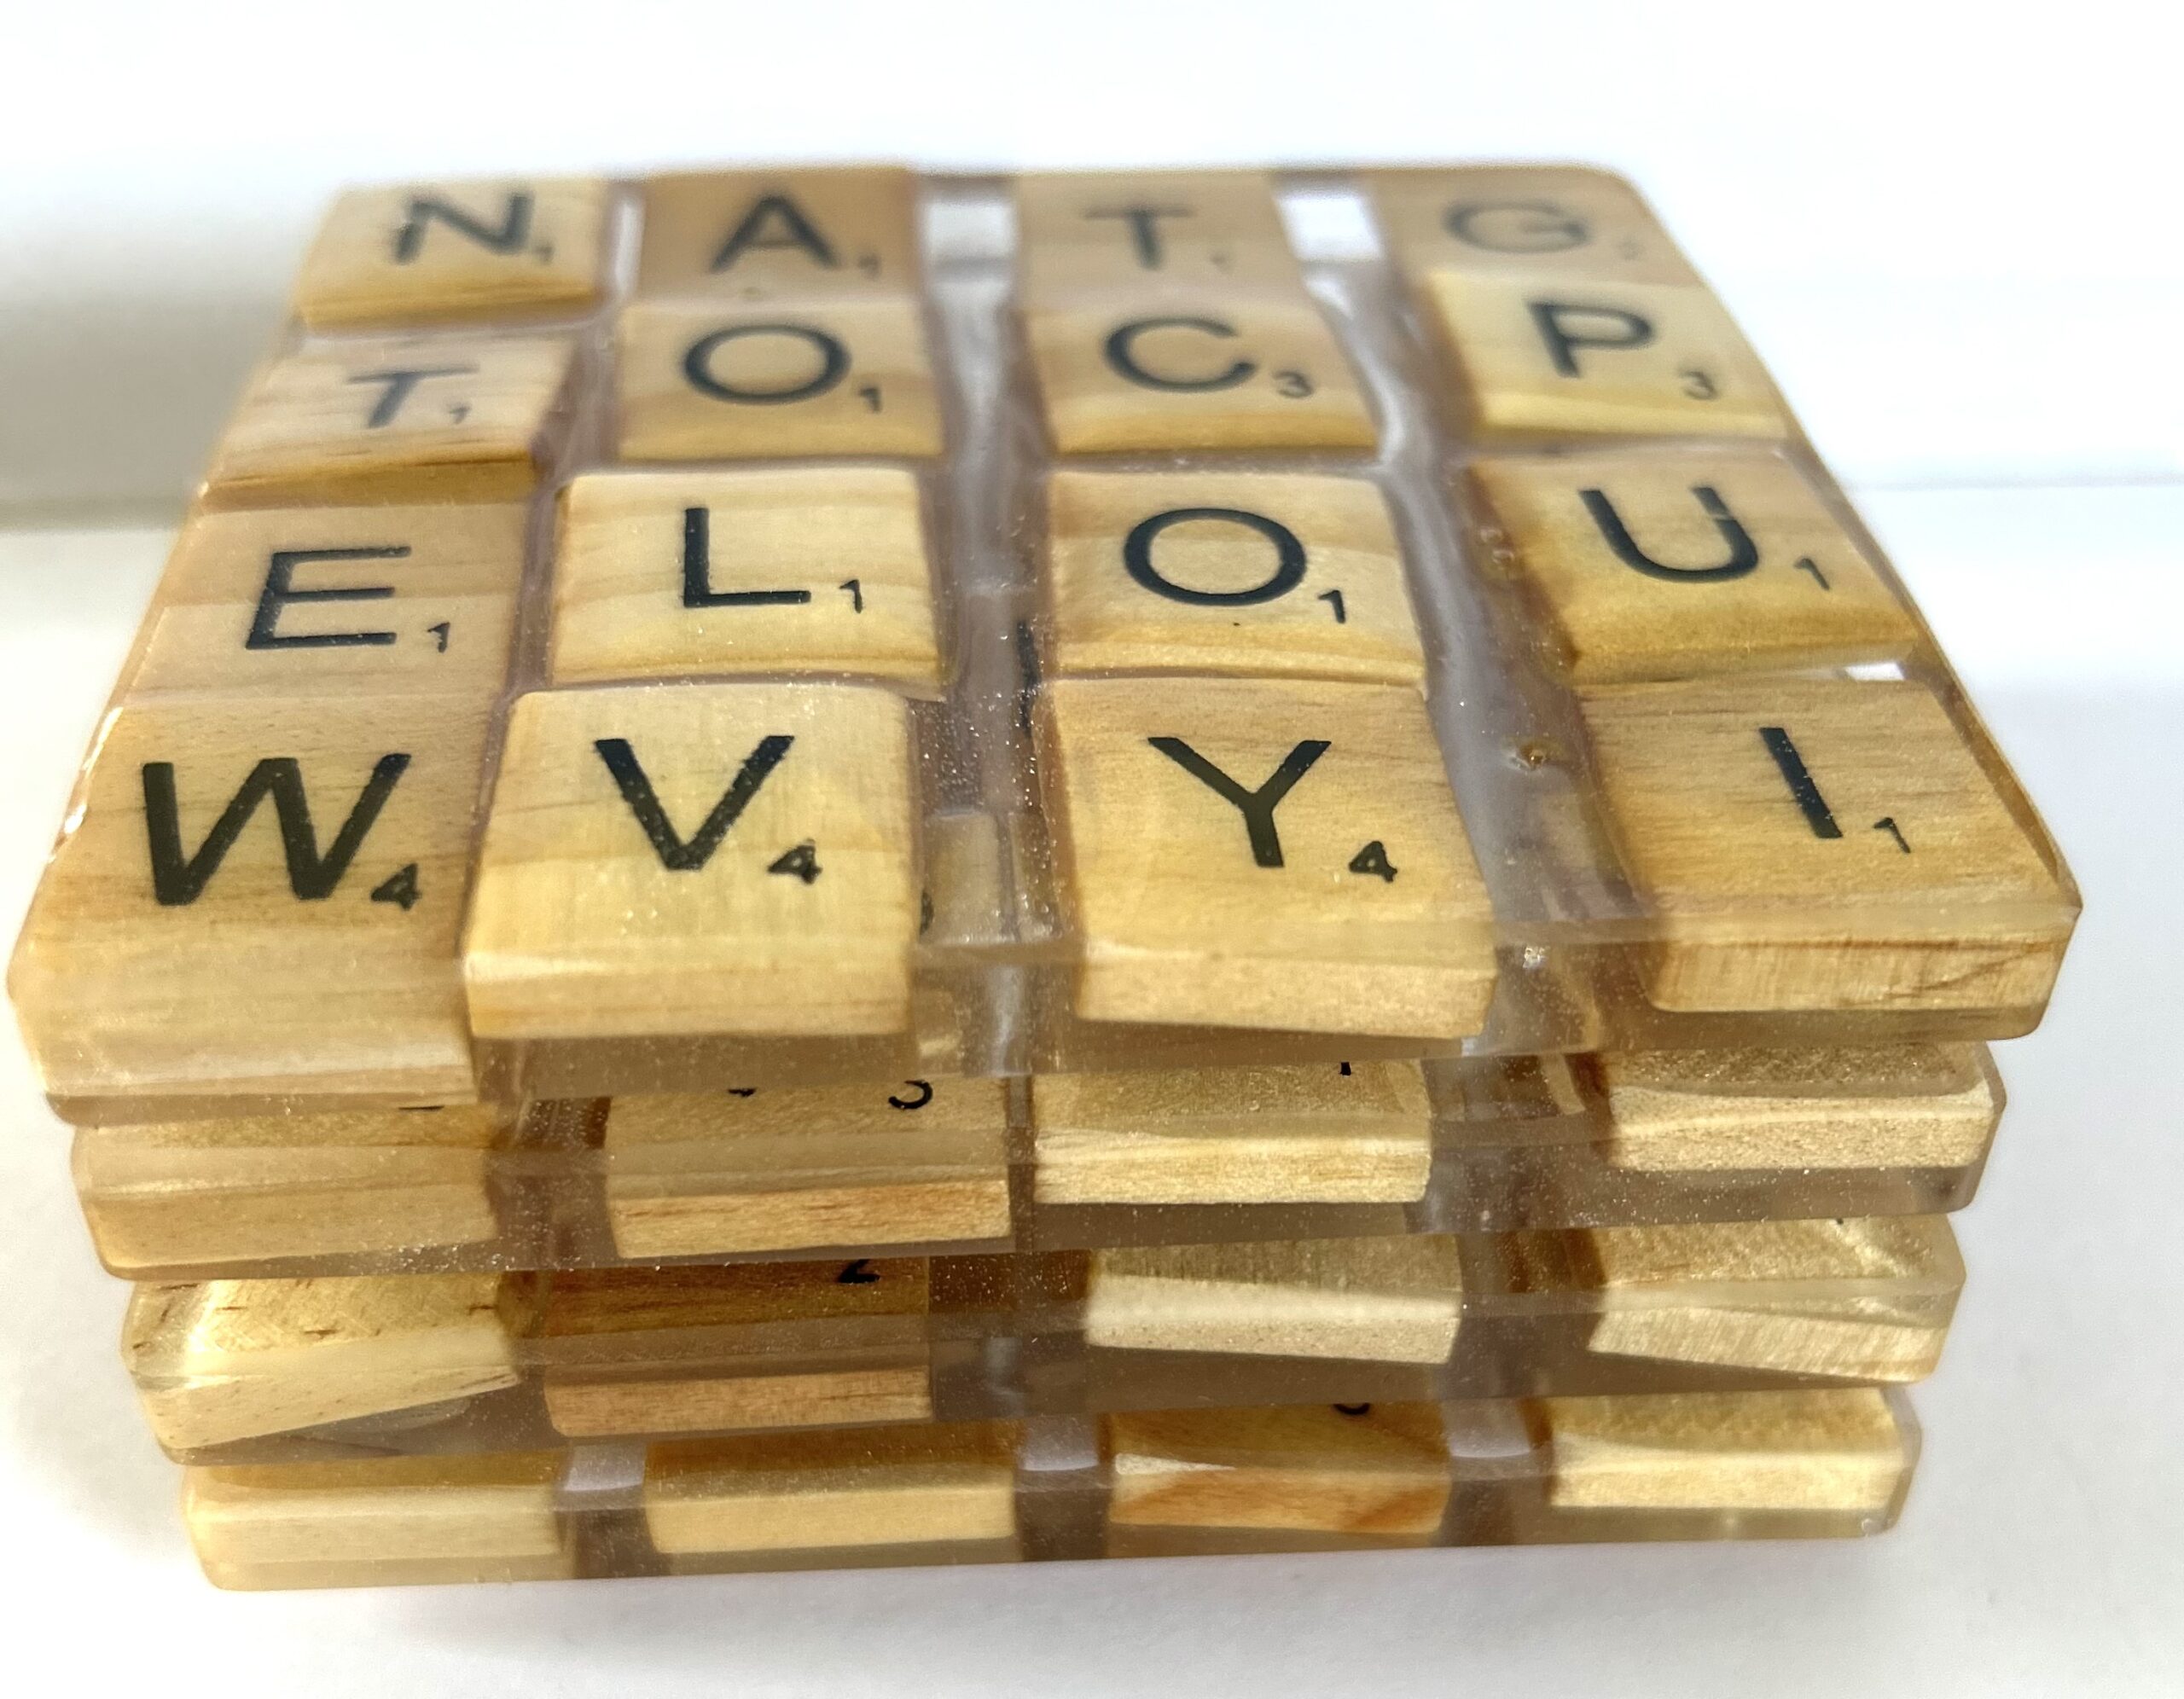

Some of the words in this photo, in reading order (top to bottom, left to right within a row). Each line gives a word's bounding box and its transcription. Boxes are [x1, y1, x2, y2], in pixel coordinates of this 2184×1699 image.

[393, 192, 533, 264] N
[711, 193, 840, 270] A
[1082, 204, 1197, 270] T
[1441, 198, 1592, 253] G
[347, 364, 479, 428] T
[682, 325, 849, 404] O
[1103, 316, 1258, 392] C
[1272, 371, 1314, 398] 3
[1527, 299, 1655, 378] P
[1678, 368, 1719, 400] 3
[681, 507, 810, 608] L
[839, 579, 863, 612] 1
[1123, 506, 1306, 606] O
[1319, 589, 1345, 623] 1
[1581, 487, 1759, 582] U
[1795, 554, 1830, 590] 1
[246, 547, 410, 649] E
[427, 623, 450, 652] 1
[142, 753, 411, 906] W
[370, 863, 421, 910] 4
[594, 735, 794, 870] V
[768, 841, 822, 884] 4
[1147, 737, 1332, 868] Y
[1349, 841, 1397, 883] 4
[1759, 728, 1843, 838] I
[1873, 817, 1911, 853] 1
